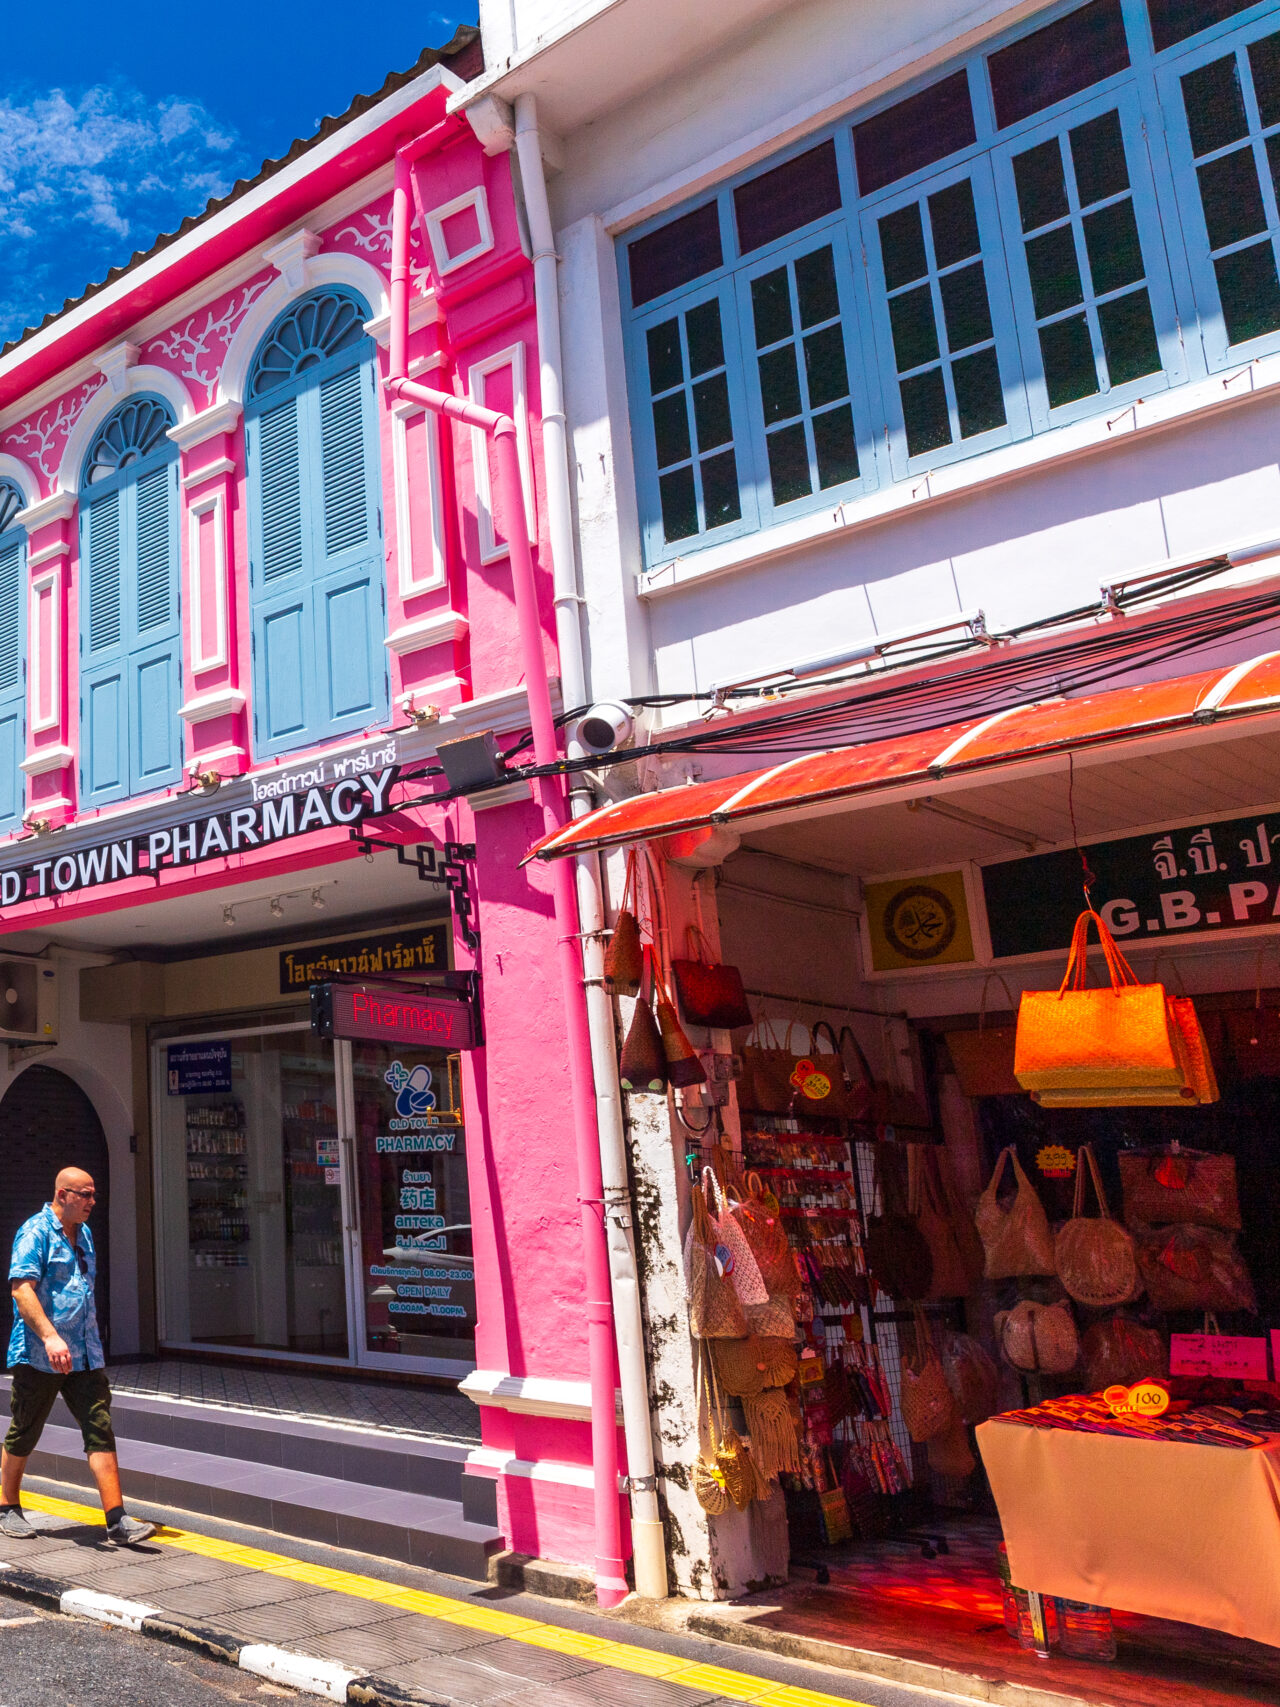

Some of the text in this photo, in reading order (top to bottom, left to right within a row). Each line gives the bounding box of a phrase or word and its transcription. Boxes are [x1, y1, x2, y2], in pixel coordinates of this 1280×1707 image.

[33, 840, 133, 896] TOWN
[149, 767, 393, 870] PHARMACY
[1229, 881, 1280, 921] P
[352, 993, 454, 1040] Pharmacy
[389, 1118, 408, 1130] OLD
[376, 1134, 455, 1152] PHARMACY
[402, 1169, 431, 1183] ร้านยา
[400, 1187, 436, 1210] 药店
[397, 1284, 452, 1299] OPEN DAILY
[1136, 1392, 1162, 1405] 100
[1116, 1406, 1137, 1414] SALE
